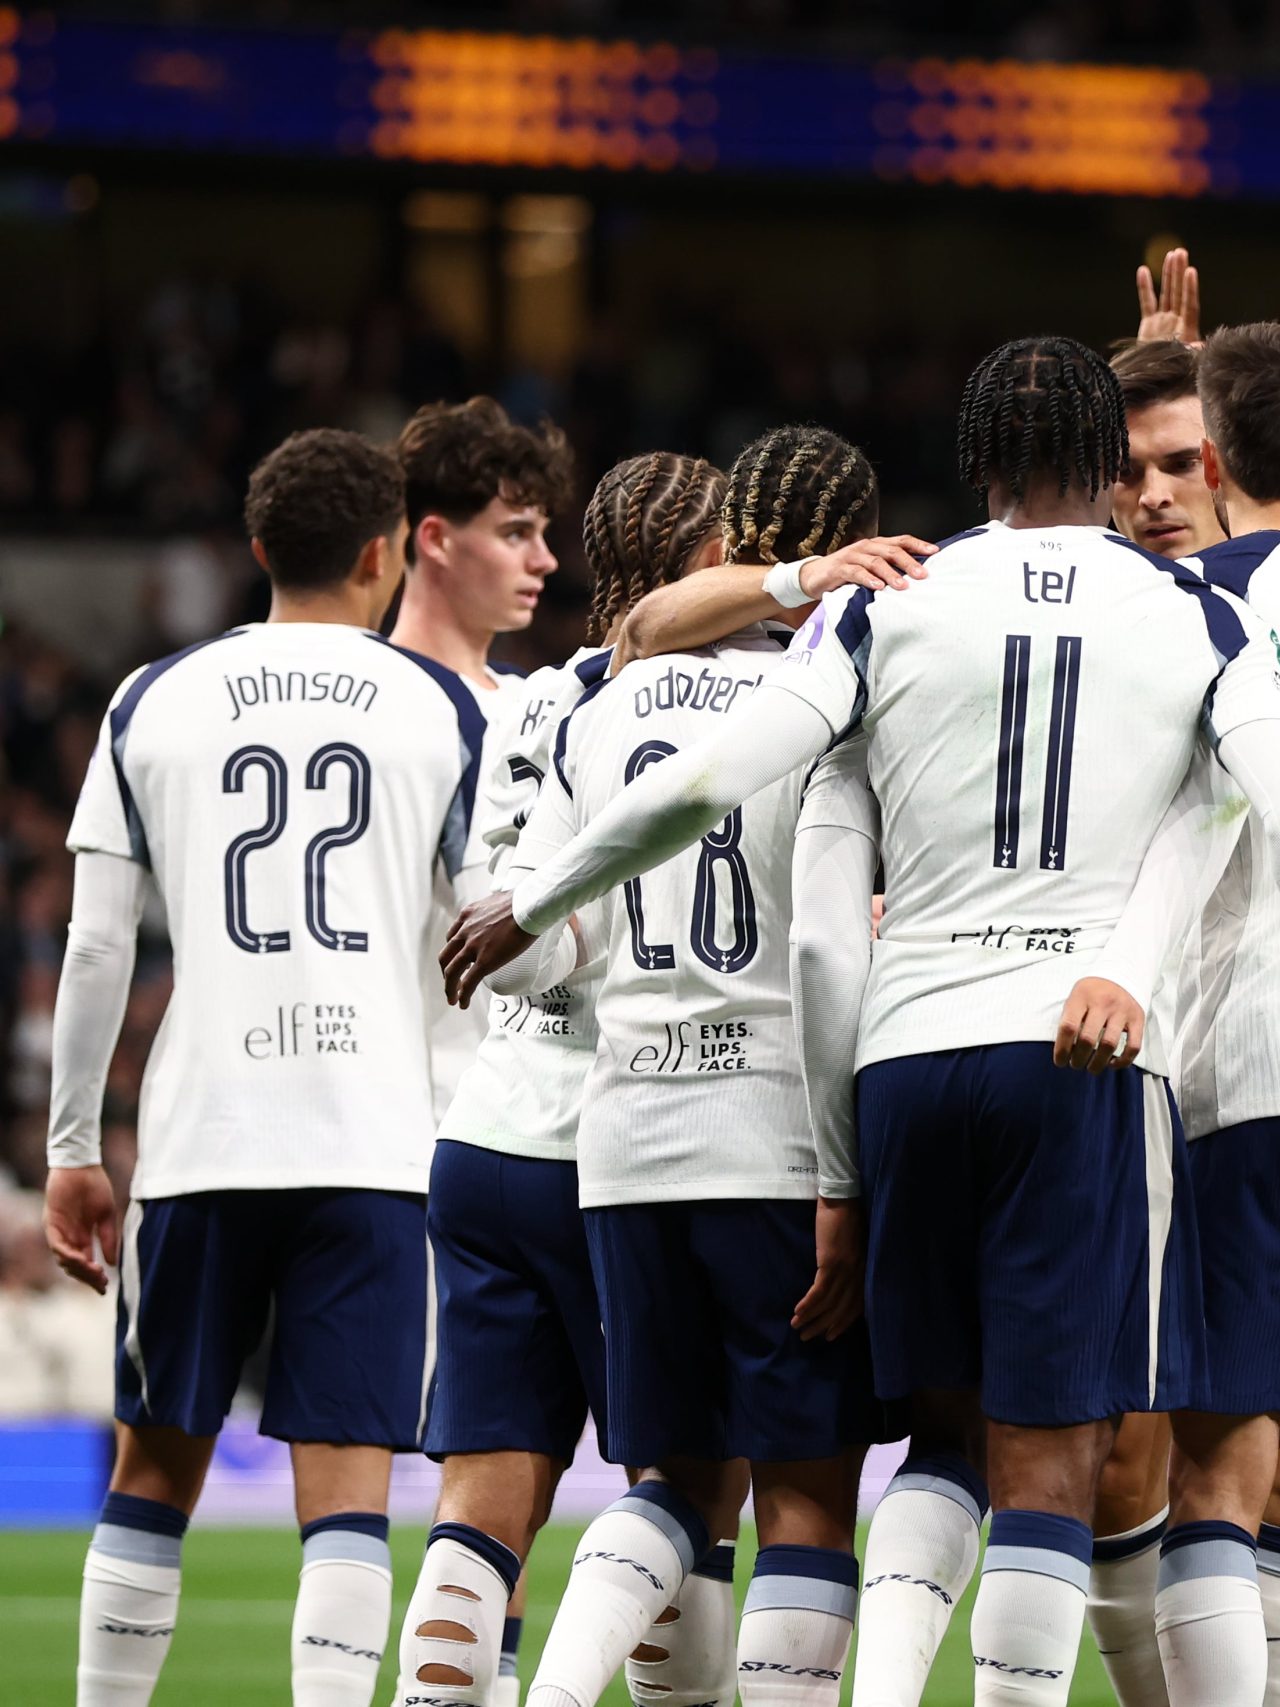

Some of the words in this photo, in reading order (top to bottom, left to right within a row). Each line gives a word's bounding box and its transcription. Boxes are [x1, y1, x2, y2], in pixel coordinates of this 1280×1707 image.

[1040, 540, 1063, 552] 895
[1023, 561, 1077, 604] tel
[222, 666, 378, 720] johnson
[993, 634, 1082, 871] 11
[222, 741, 372, 954] 22
[1025, 937, 1076, 954] FACE
[700, 1022, 754, 1040] EYES.
[701, 1041, 747, 1059] LIPS.
[697, 1057, 752, 1072] FACE.
[738, 1661, 842, 1681] SPURS
